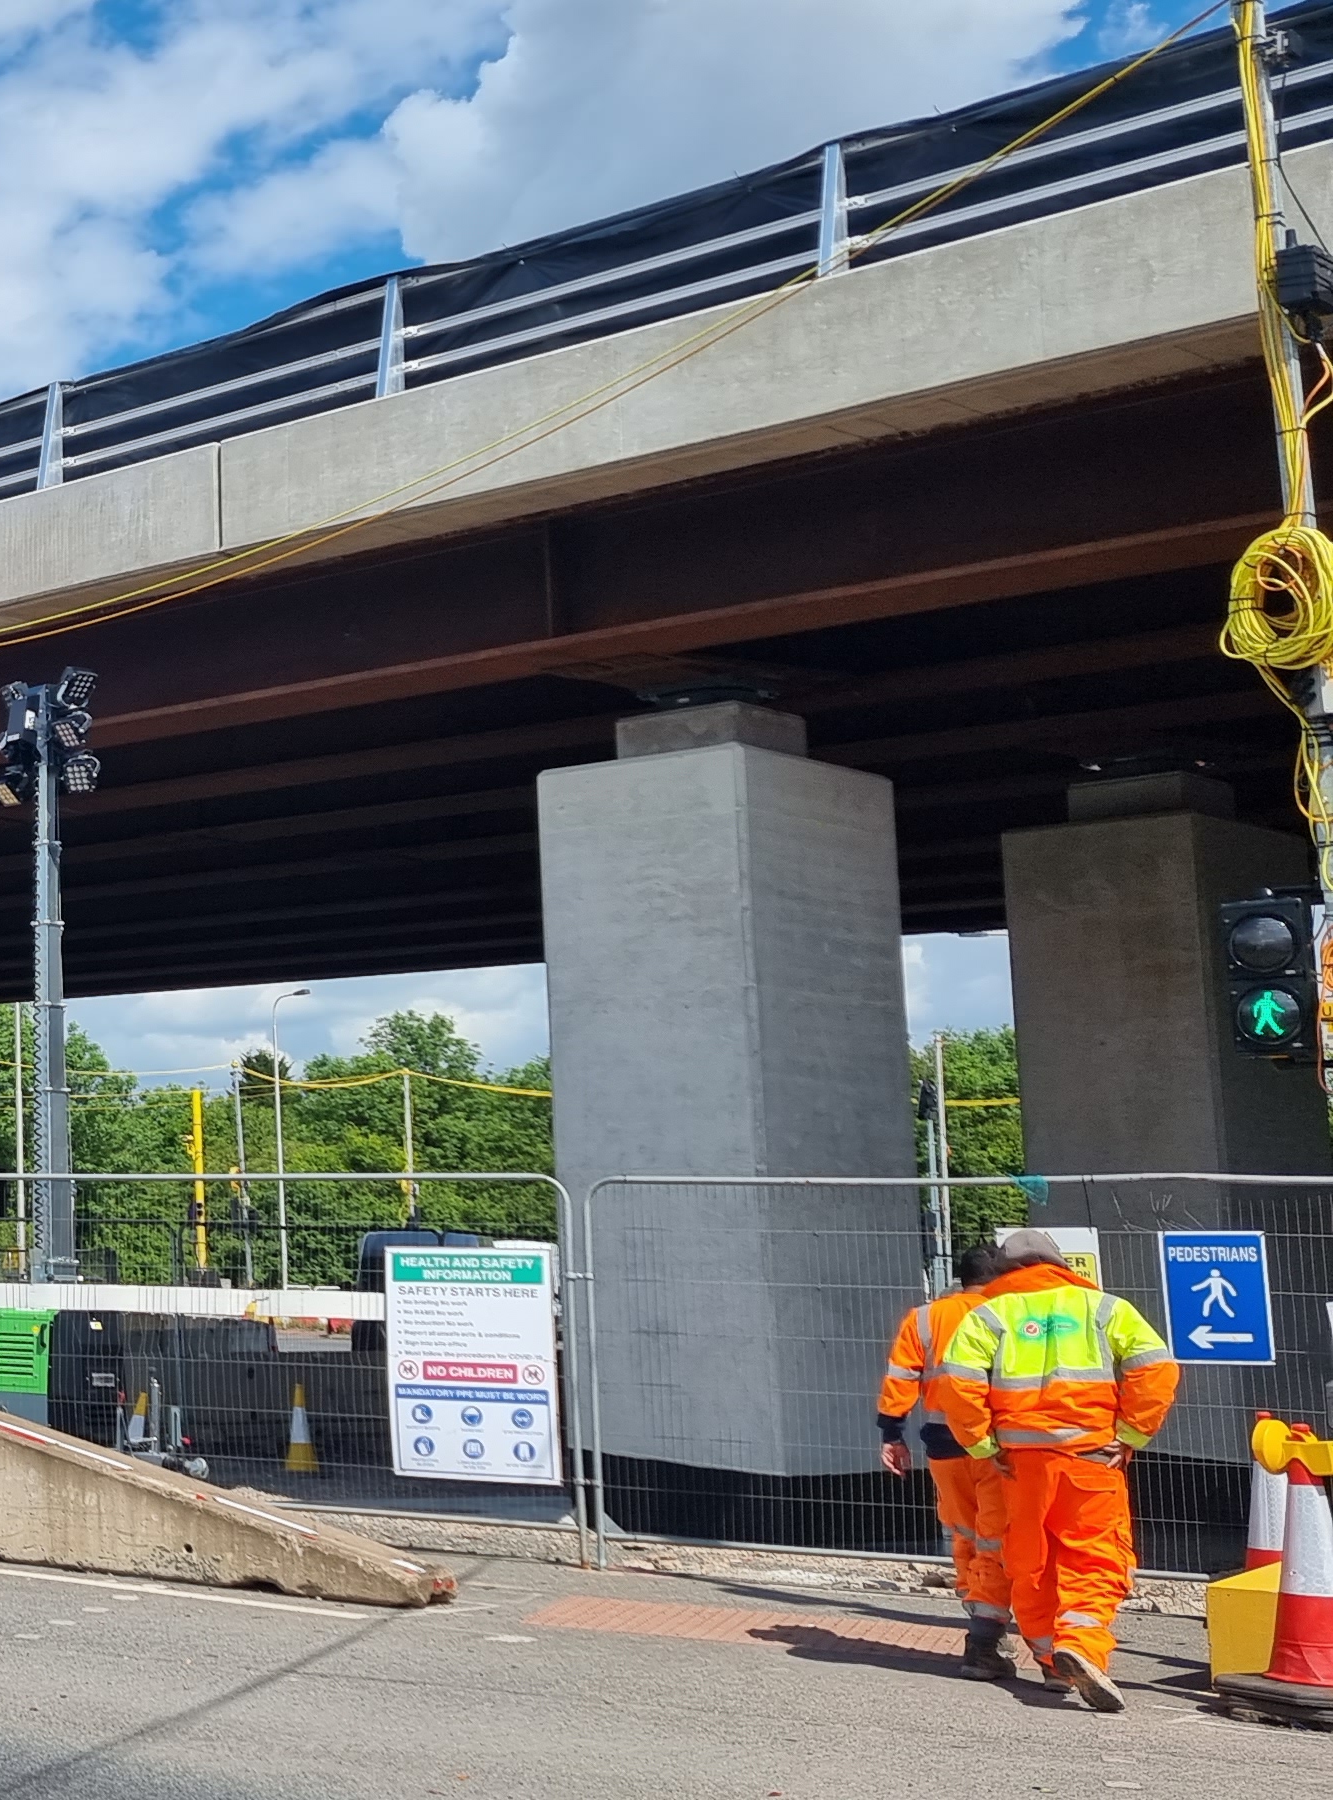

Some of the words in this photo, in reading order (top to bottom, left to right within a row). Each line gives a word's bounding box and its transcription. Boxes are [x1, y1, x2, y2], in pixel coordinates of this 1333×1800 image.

[1167, 1246, 1258, 1263] PEDESTRIANS
[400, 1256, 450, 1268] HEALTH
[452, 1257, 480, 1268] AND
[481, 1257, 534, 1269] SAFETY
[422, 1269, 512, 1281] INFORMATION
[398, 1285, 448, 1296] SAFETY
[450, 1286, 501, 1298] STARTS
[503, 1287, 539, 1299] HERE
[426, 1364, 447, 1377] NO
[448, 1366, 514, 1379] CHILDREN
[397, 1386, 454, 1397] MANDATORY
[456, 1389, 474, 1399] PPE
[475, 1389, 501, 1400] MUST
[503, 1391, 515, 1401] BE
[516, 1392, 546, 1401] WORN
